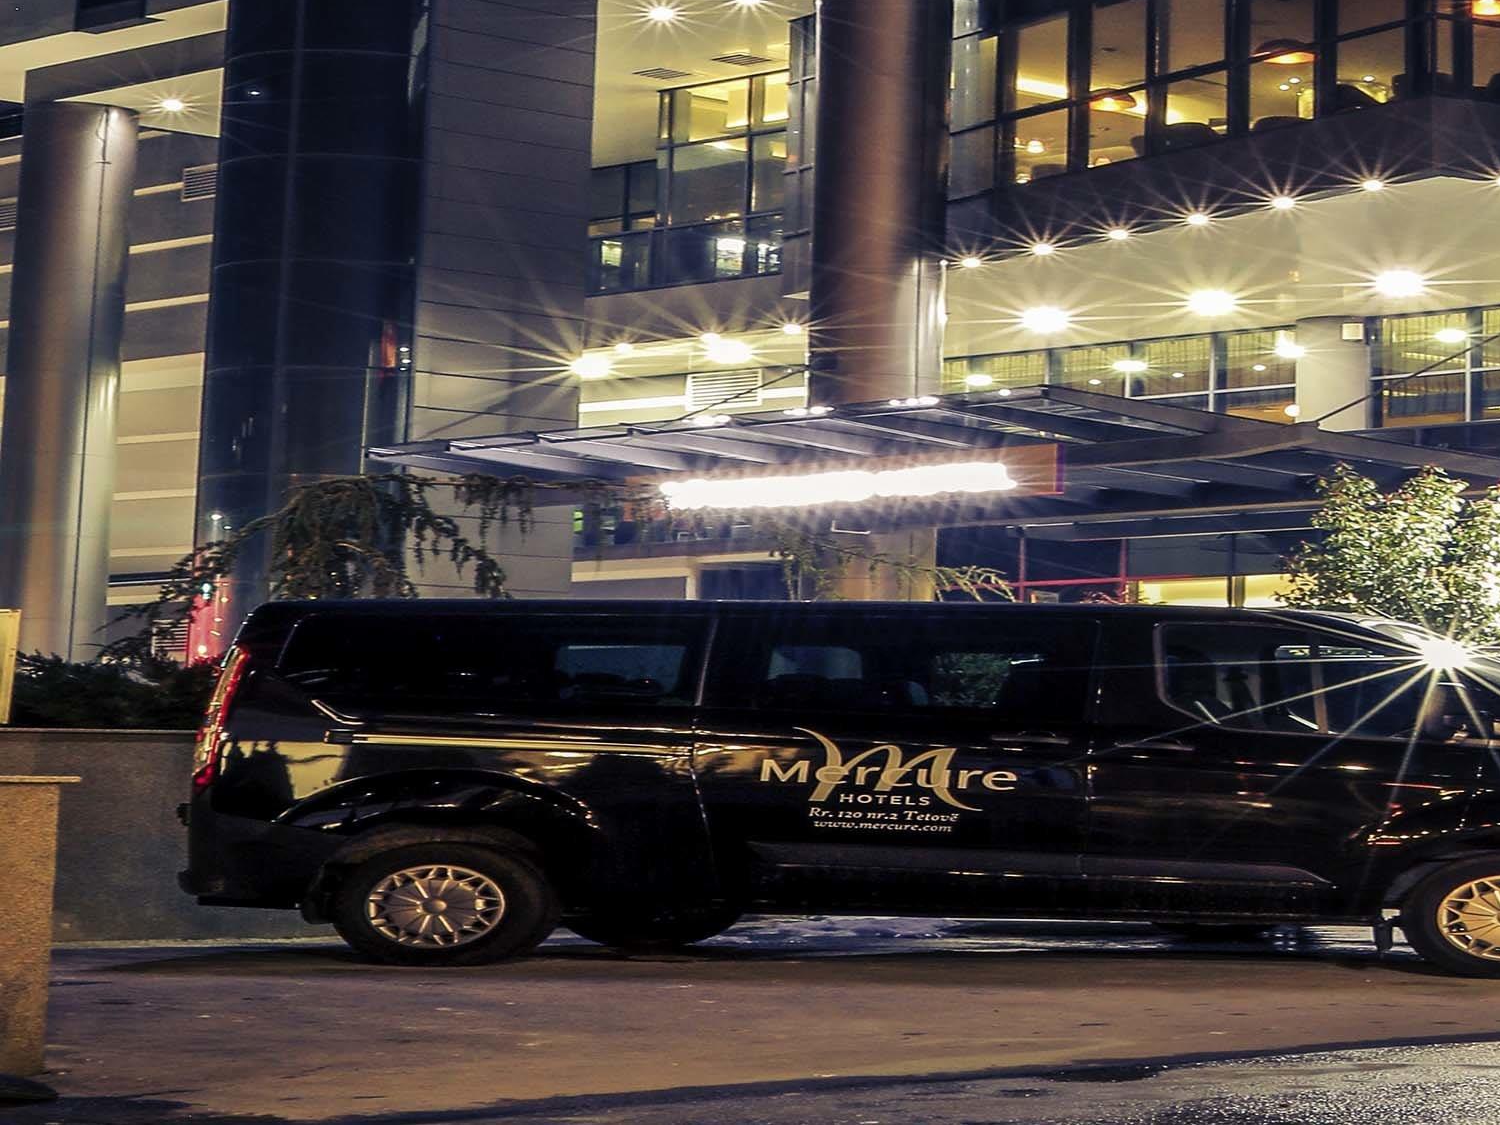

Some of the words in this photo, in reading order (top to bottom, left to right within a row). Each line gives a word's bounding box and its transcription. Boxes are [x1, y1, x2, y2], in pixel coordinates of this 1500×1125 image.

[759, 759, 1018, 791] Mercure
[839, 793, 931, 806] HOTELS
[813, 820, 953, 832] www.mercure.com
